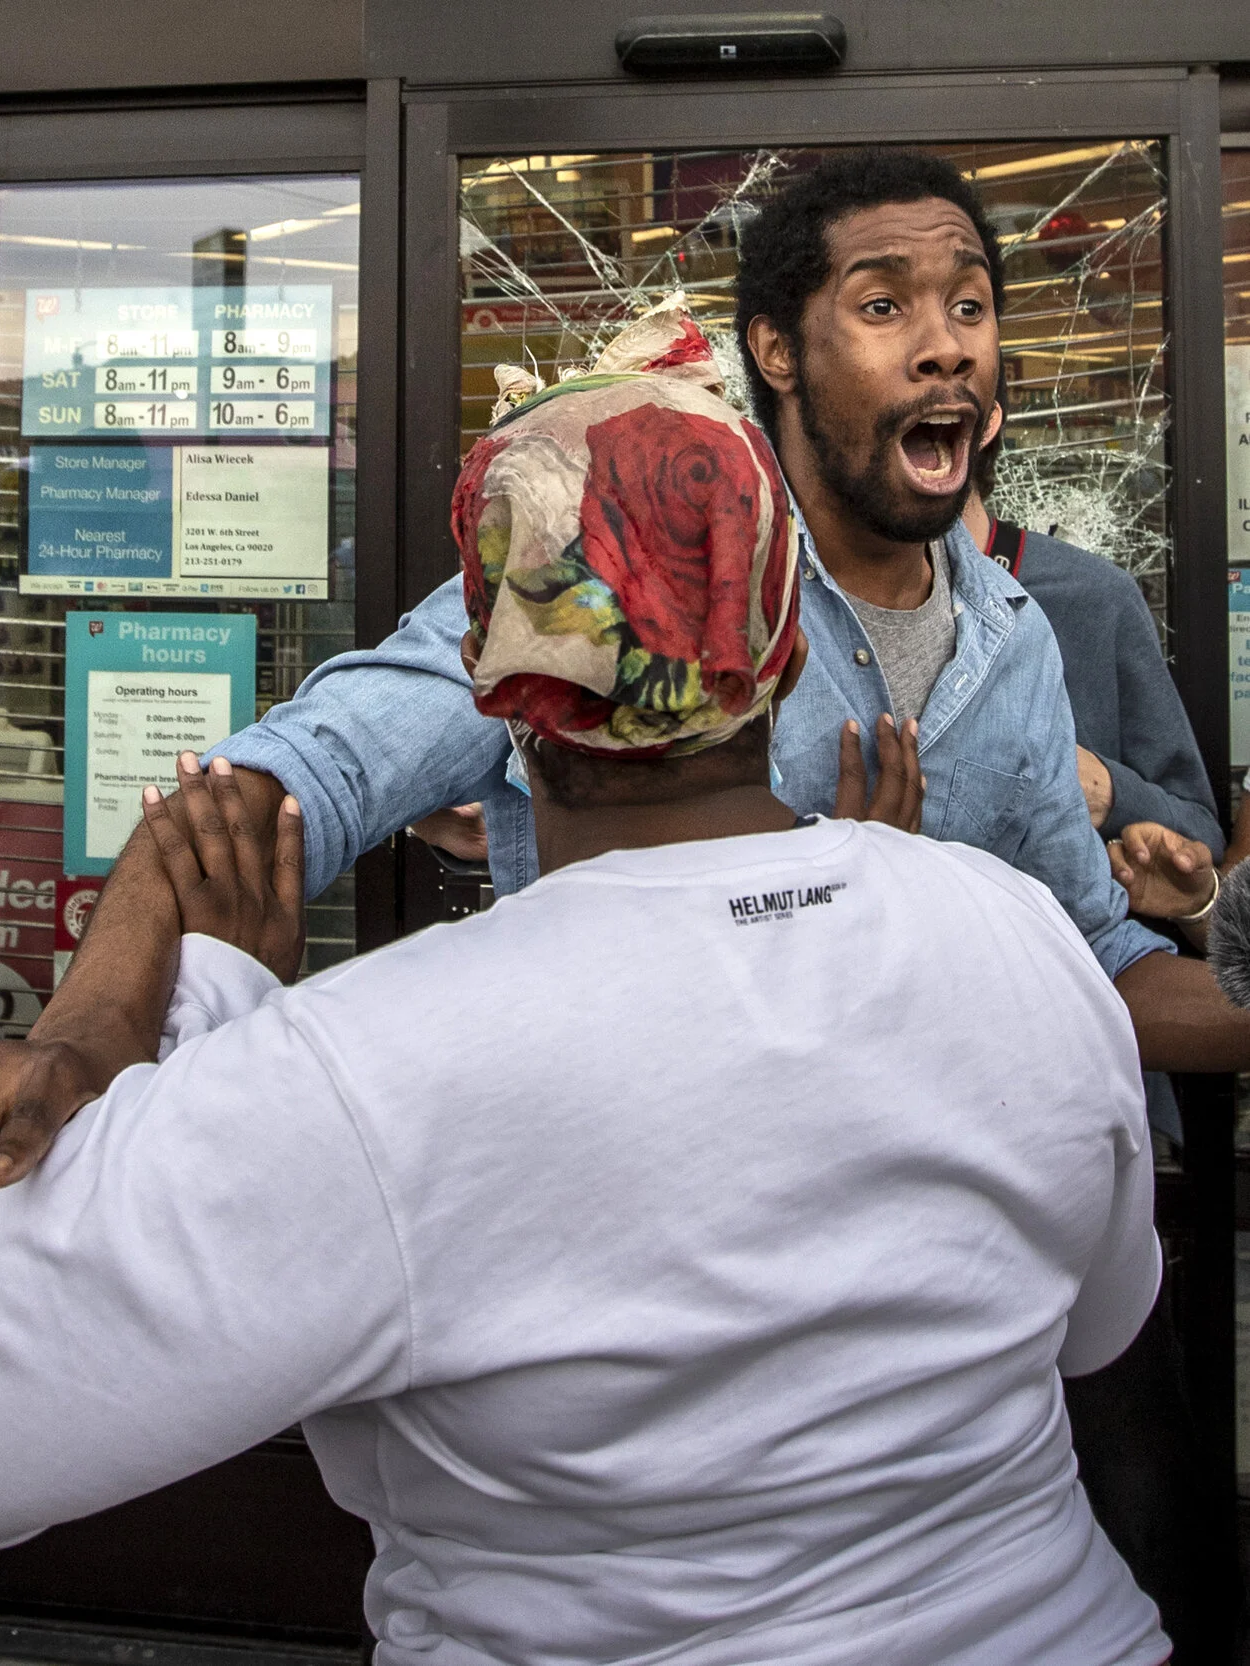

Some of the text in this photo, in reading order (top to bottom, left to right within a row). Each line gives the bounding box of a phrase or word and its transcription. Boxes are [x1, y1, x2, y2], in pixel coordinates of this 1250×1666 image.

[117, 304, 178, 321] STORE
[214, 304, 315, 319] PHARMACY
[42, 371, 81, 389] SAT
[38, 406, 82, 424] SUN
[55, 456, 147, 472] Store Manager
[186, 454, 254, 464] Alisa Wiecek
[40, 485, 162, 503] Pharmacy Manager
[186, 491, 259, 502] Edessa Daniel
[74, 528, 127, 543] Nearest
[185, 528, 205, 536] 3201
[219, 528, 233, 536] 6th
[235, 528, 259, 537] Street
[38, 544, 163, 563] 24-Hour Pharmacy
[185, 543, 199, 551] Los
[235, 543, 246, 551] Ca
[247, 544, 274, 552] 90020
[119, 621, 231, 645] Pharmacy
[142, 645, 206, 663] hours
[115, 686, 198, 698] Operating hours
[94, 773, 178, 783] Pharmacist meal brea
[729, 884, 832, 918] HELMUT LANG
[735, 918, 749, 926] THE
[750, 914, 772, 925] ARTIST
